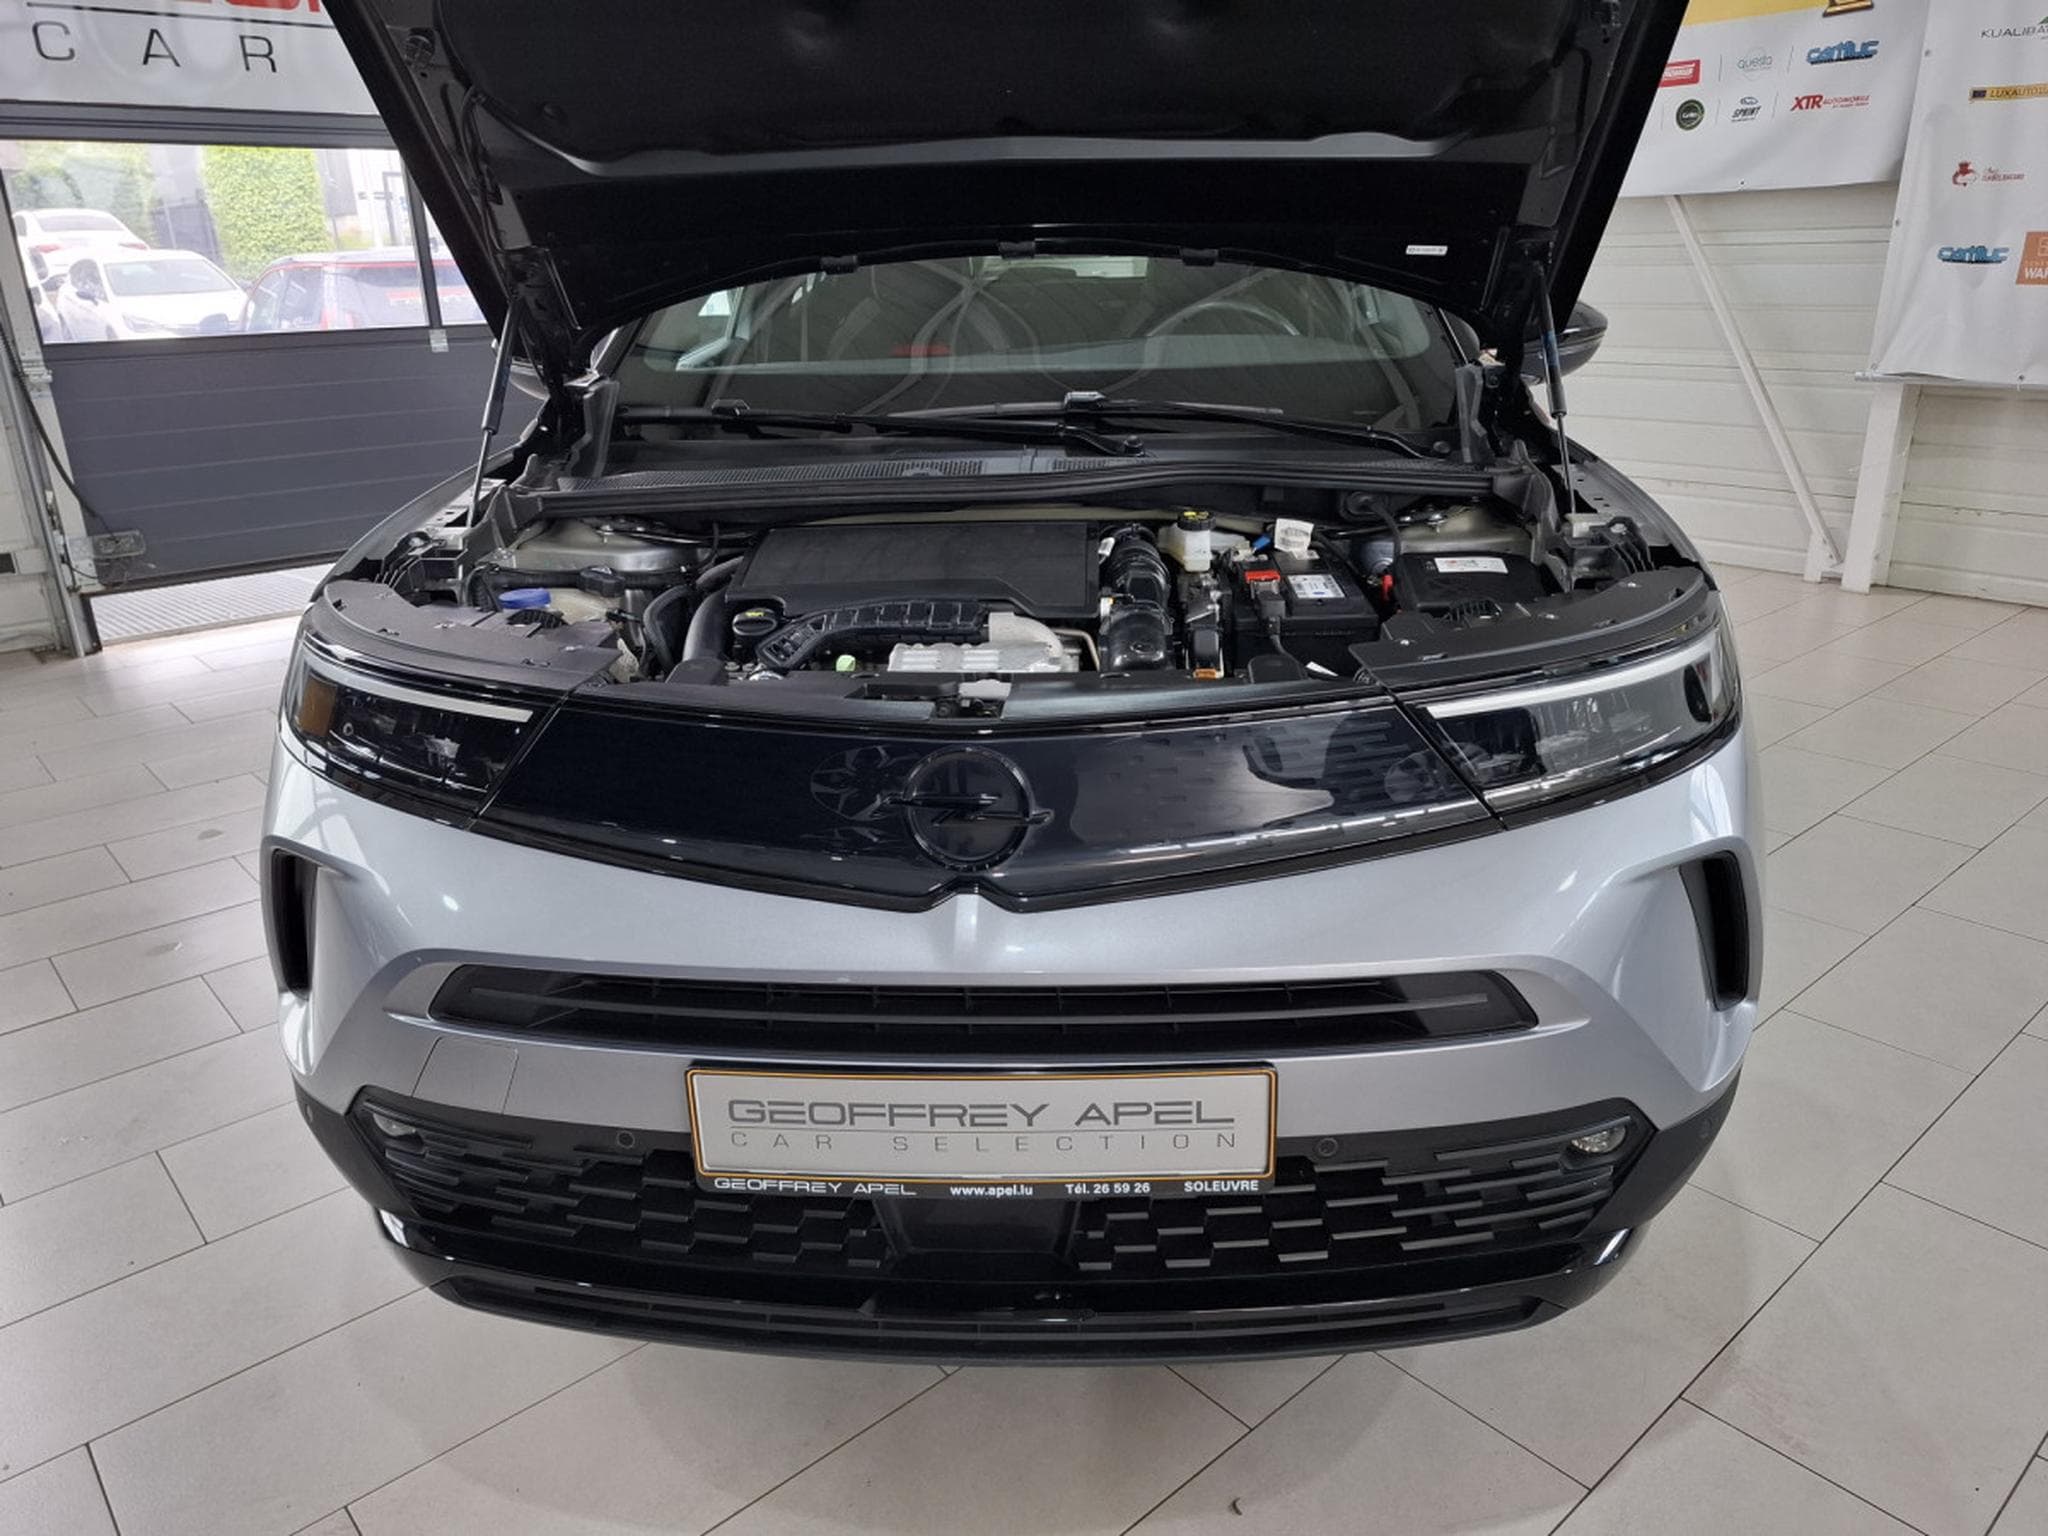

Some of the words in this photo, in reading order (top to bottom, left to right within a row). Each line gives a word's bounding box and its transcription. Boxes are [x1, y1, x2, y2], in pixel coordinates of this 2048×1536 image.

[32, 20, 278, 73] CAR
[1732, 105, 1762, 119] SPRINT
[1790, 94, 1824, 111] XTR
[728, 1099, 1049, 1127] GEOFFREY
[1075, 1101, 1235, 1126] APEL
[731, 1131, 833, 1150] CAR
[893, 1133, 1236, 1152] SELECTION
[714, 1178, 842, 1194] GEOFFREY
[853, 1183, 917, 1196] APEL
[950, 1184, 1033, 1198] www.apel.lu
[1065, 1183, 1090, 1195] Tél.
[1093, 1183, 1110, 1194] 26
[1113, 1183, 1130, 1194] 59
[1134, 1182, 1151, 1194] 26
[1184, 1180, 1259, 1193] SOLEUVRE
